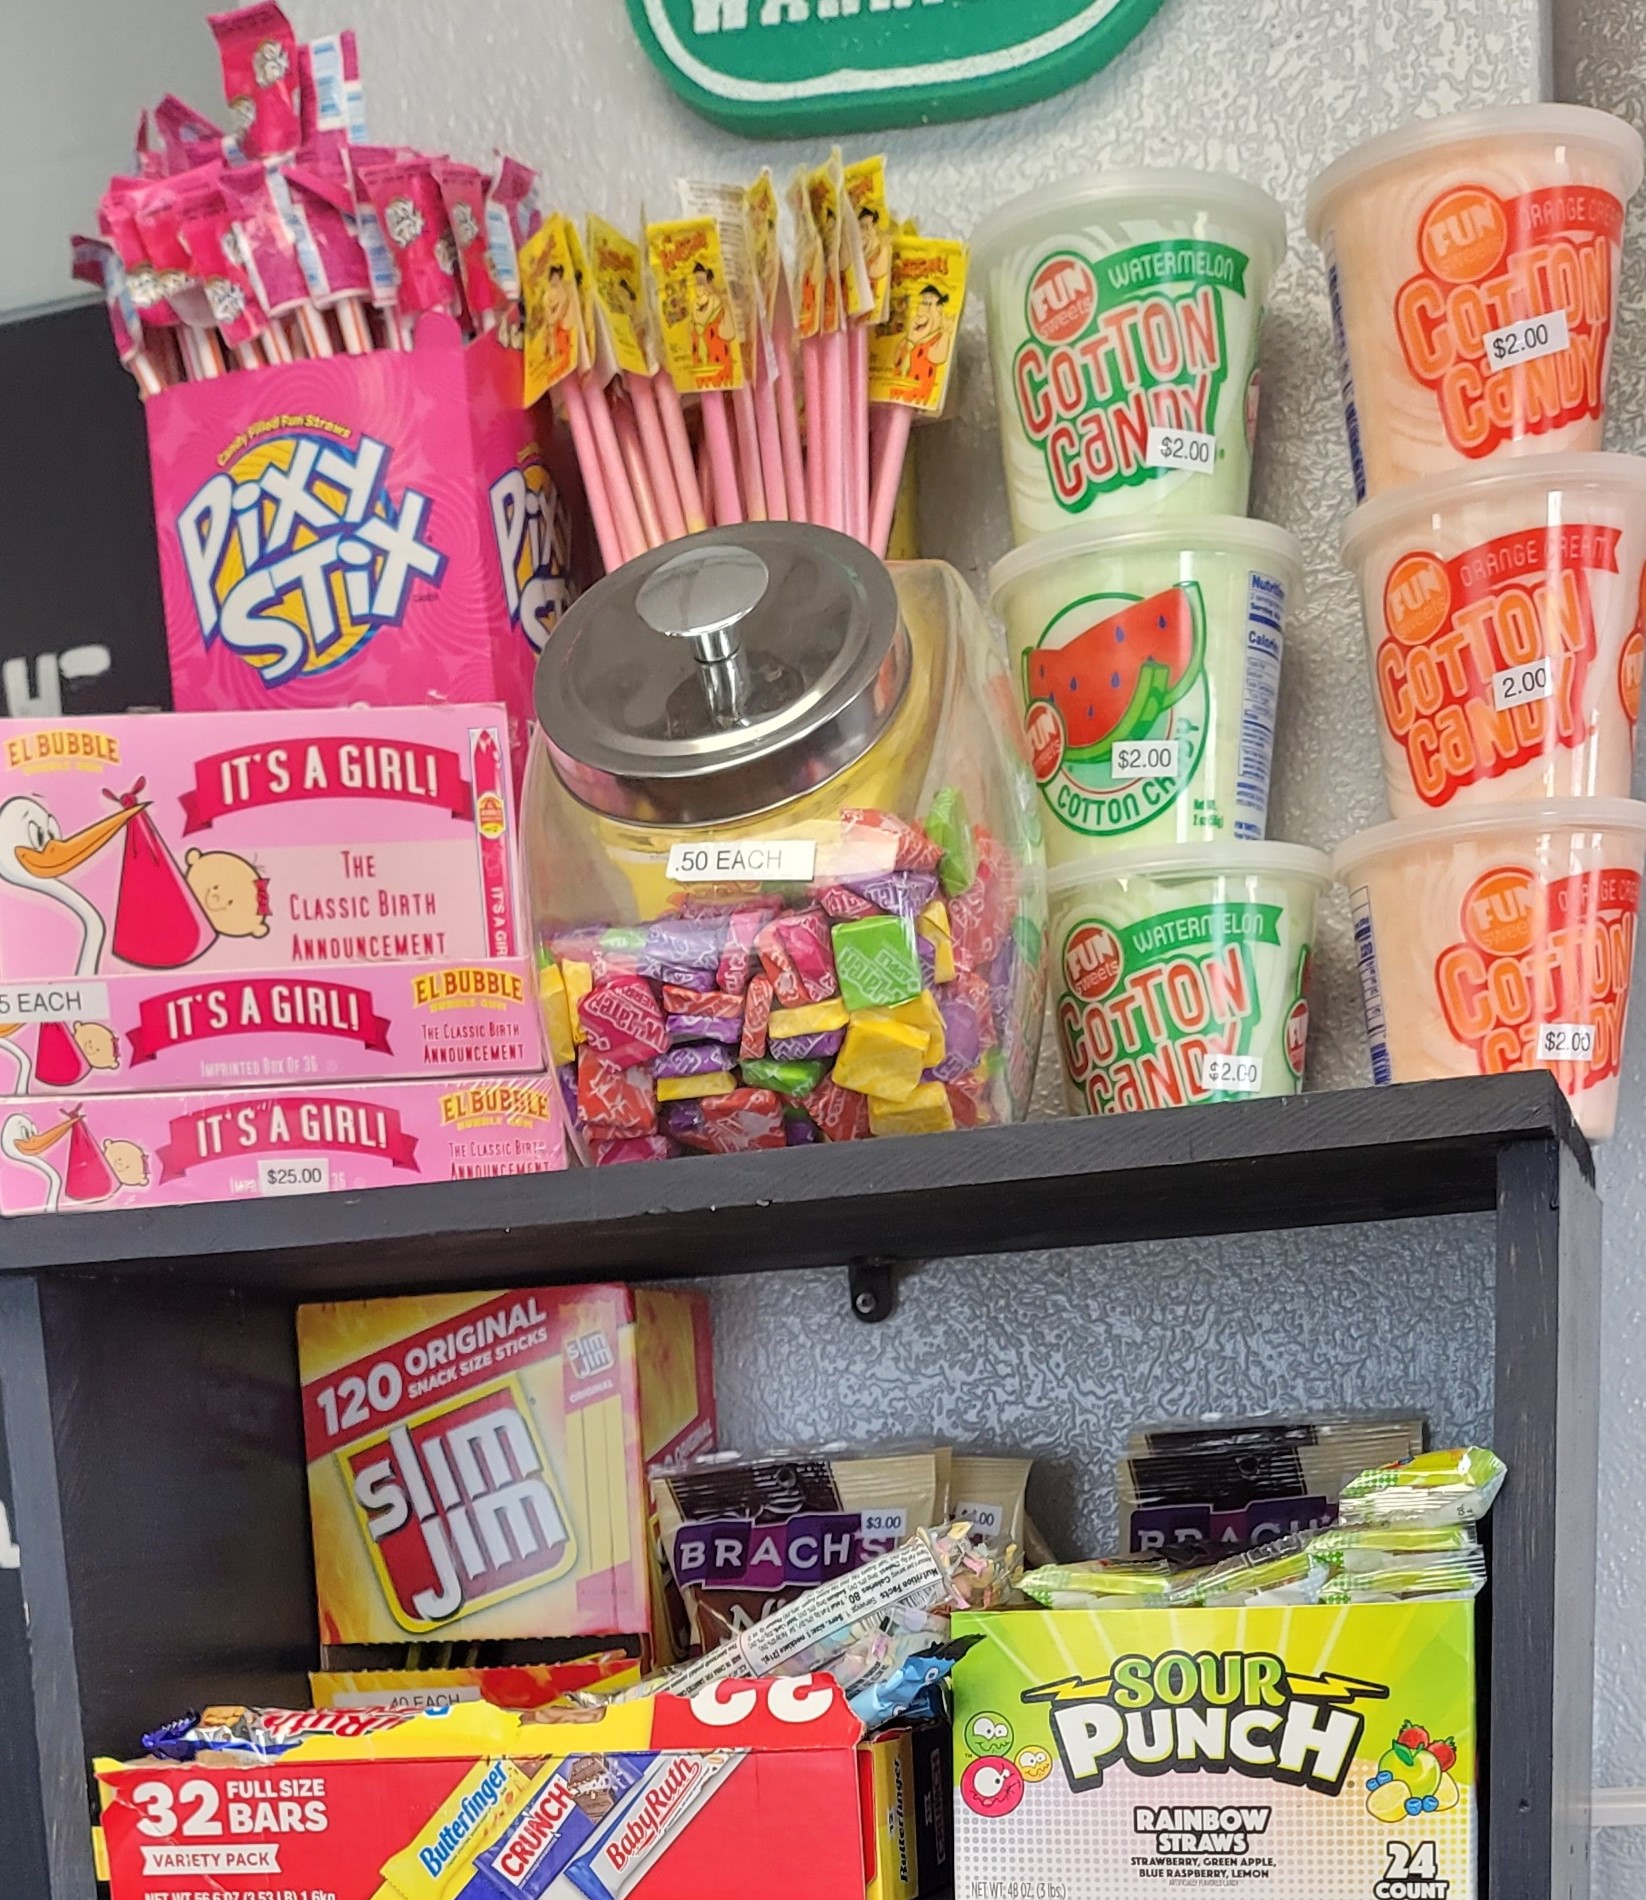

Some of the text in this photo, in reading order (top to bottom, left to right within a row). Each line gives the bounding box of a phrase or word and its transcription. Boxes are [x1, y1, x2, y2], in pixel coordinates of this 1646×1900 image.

[1427, 202, 1496, 258] FUN
[1107, 251, 1235, 290] WATERMELON
[1031, 263, 1088, 322] FUN
[1397, 235, 1608, 381] COTTON
[1492, 324, 1548, 360] $2.00
[1015, 286, 1218, 436] COTTON
[1160, 436, 1209, 463] $2.00
[1460, 540, 1538, 588] ORANGE
[1390, 563, 1441, 621] FUN
[1377, 568, 1587, 736] COTTON
[1502, 667, 1547, 698] 2.00
[8, 732, 119, 767] EL BUBBLE
[1117, 748, 1171, 769] $2.00
[220, 745, 439, 804] IT'S A GIRL!
[675, 850, 782, 871] .50 EACH
[1472, 881, 1538, 931] FUN
[1066, 932, 1114, 980] FUN
[18, 990, 82, 1014] EACH
[416, 970, 523, 1004] EL BUBBLE
[167, 985, 359, 1040] IT'S A GIRL!
[1059, 947, 1248, 1080] COTTON
[1544, 1031, 1591, 1052] $2.00
[1209, 1061, 1258, 1083] $2.00
[444, 1099, 466, 1123] EL
[198, 1103, 387, 1158] IT'S A GIRL!
[267, 1168, 322, 1186] $25.00
[404, 1297, 547, 1376] ORIGINAL
[408, 1327, 548, 1399] SNACK SIZE STICKS
[317, 1361, 402, 1436] 120
[866, 1515, 902, 1530] $3.00
[1112, 1655, 1287, 1708] SOUR
[414, 1694, 460, 1709] EACH
[1055, 1701, 1361, 1785] PUNCH
[227, 1779, 326, 1799] FULL SIZE
[133, 1780, 223, 1837] 32
[230, 1801, 328, 1834] BARS
[419, 1760, 510, 1878] Butterfinger
[1136, 1808, 1269, 1832] RAINBOW
[499, 1776, 571, 1879] CRUNCH
[1158, 1834, 1247, 1854] STRAWS
[152, 1851, 270, 1869] VARIETY PACK
[1130, 1857, 1277, 1868] STRAWBERRY, GREEN APPLE,
[1139, 1868, 1269, 1879] BLUE RASPBERRY, LEMON
[1386, 1843, 1437, 1880] 24
[971, 1882, 988, 1899] NET
[1375, 1882, 1449, 1900] COUNT
